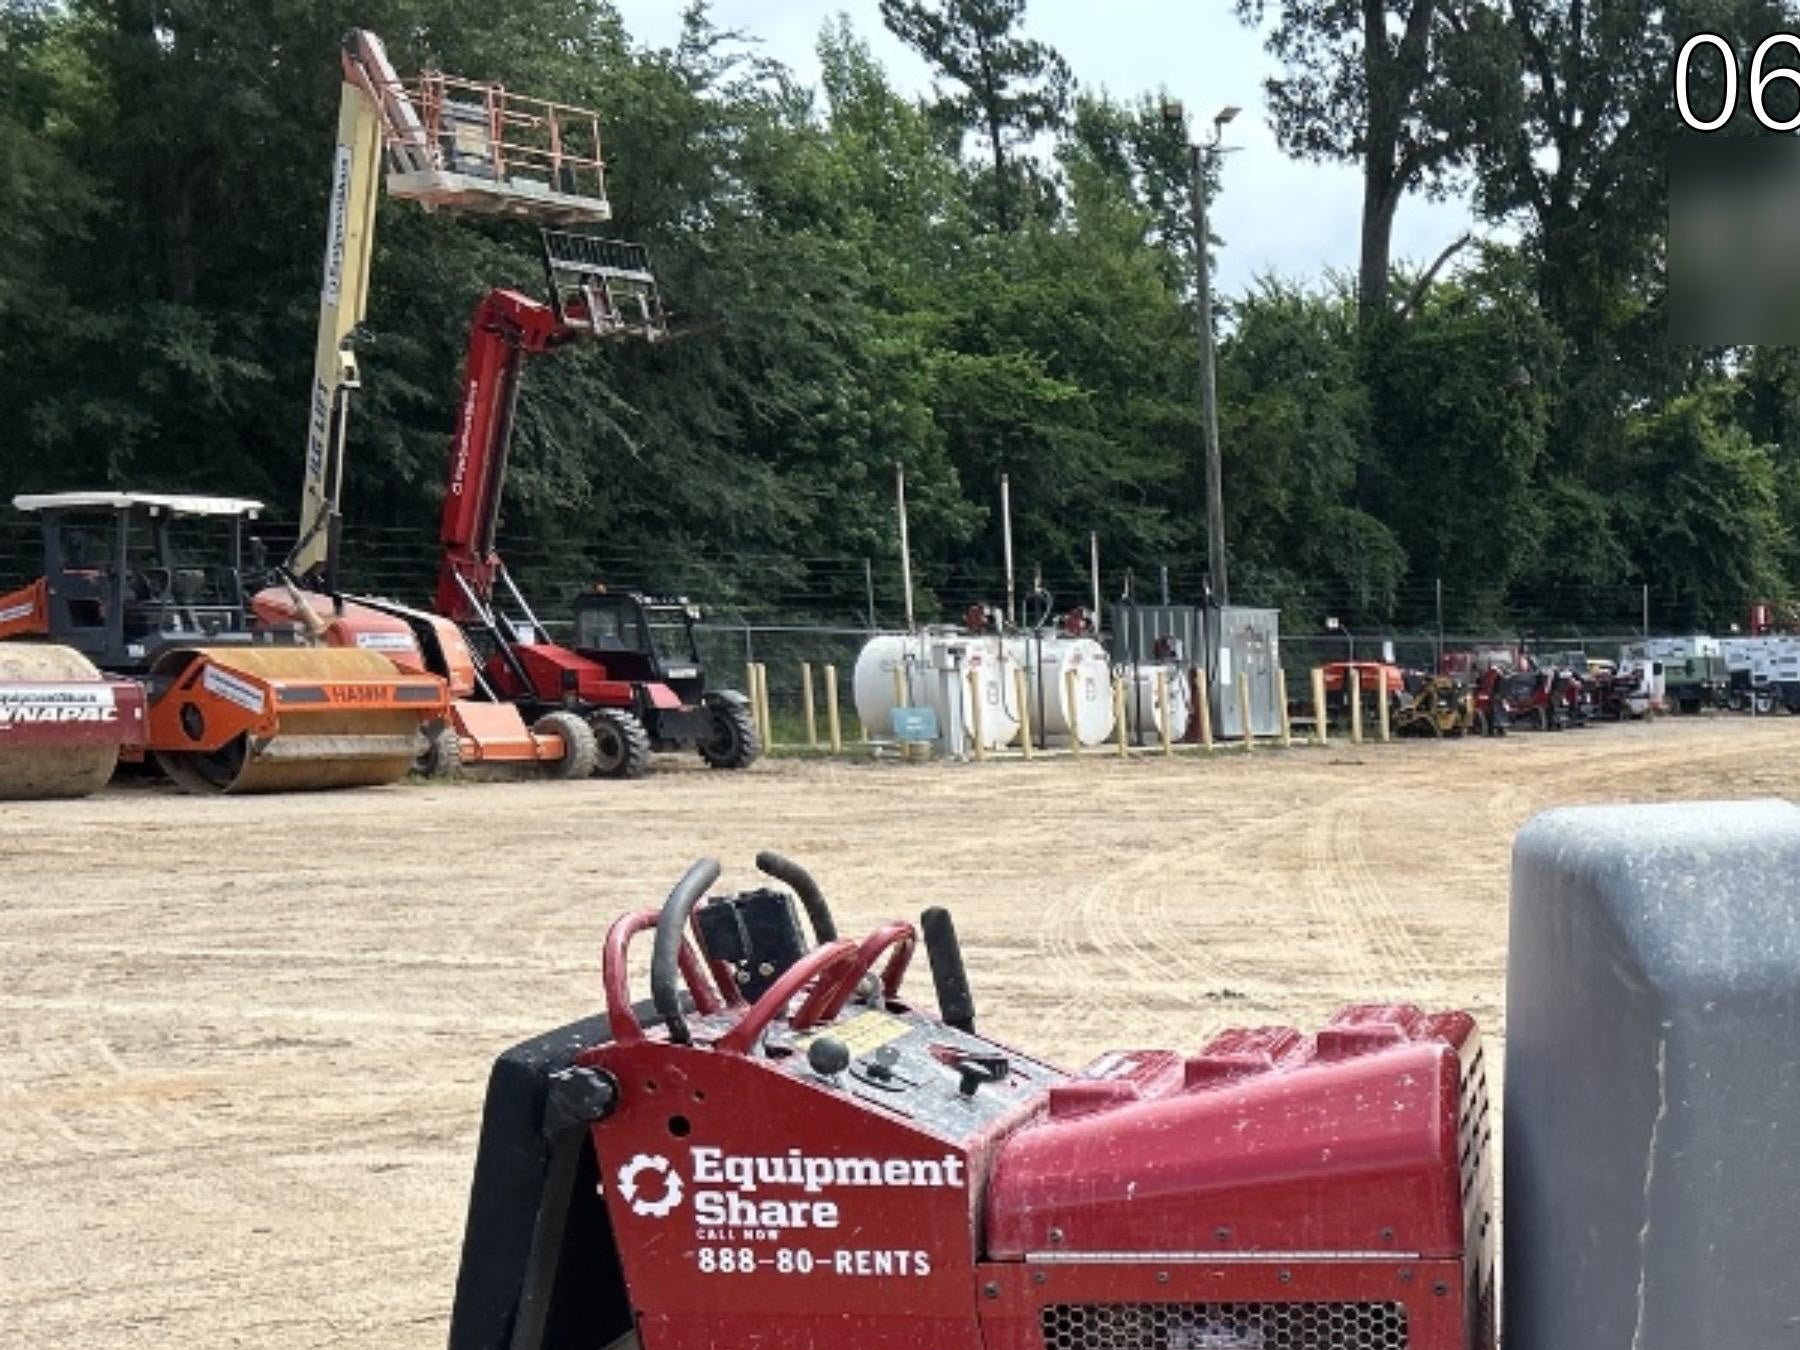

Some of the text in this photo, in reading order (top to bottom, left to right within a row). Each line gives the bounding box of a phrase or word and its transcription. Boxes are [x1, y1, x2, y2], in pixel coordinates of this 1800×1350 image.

[690, 1146, 965, 1192] Equipment
[694, 1191, 840, 1228] Share
[696, 1229, 780, 1241] CALL NOW
[698, 1247, 931, 1277] 888-80-RENTS
